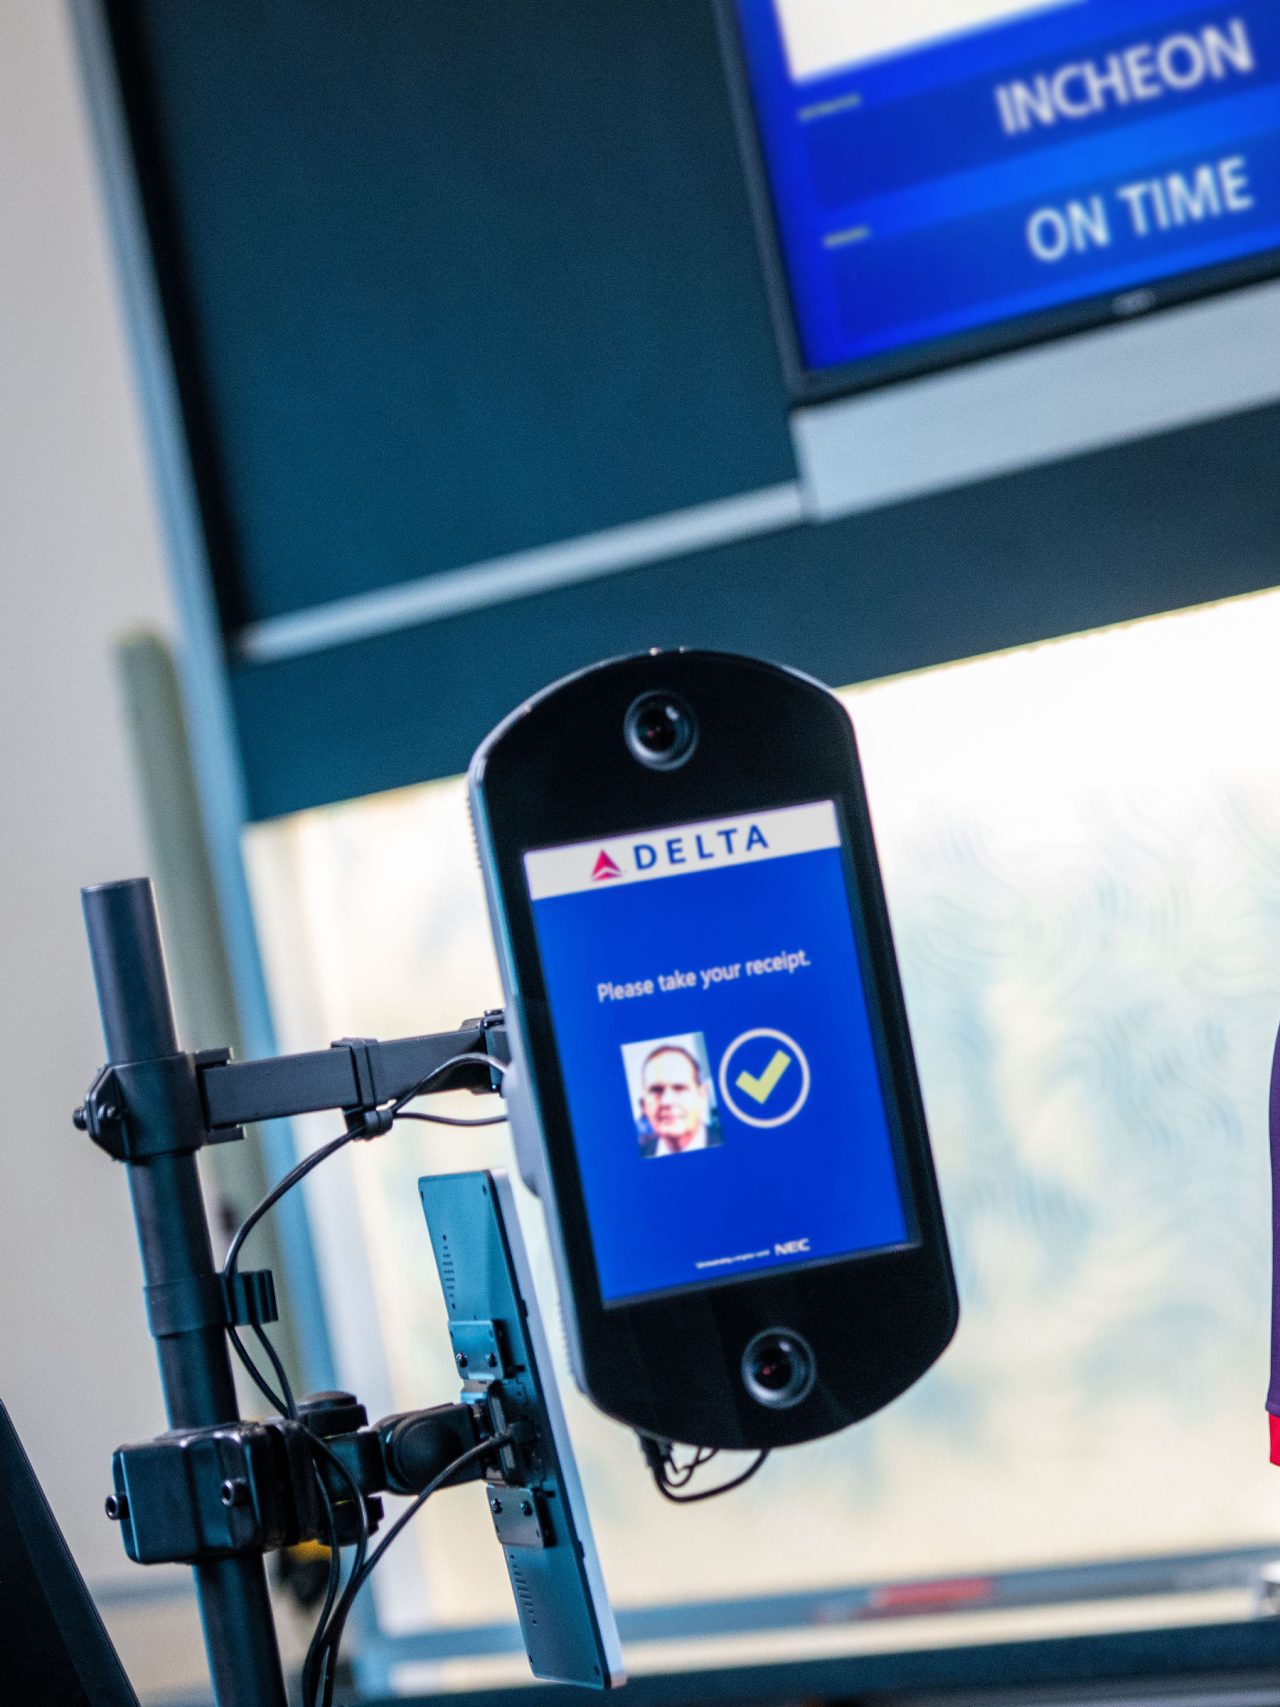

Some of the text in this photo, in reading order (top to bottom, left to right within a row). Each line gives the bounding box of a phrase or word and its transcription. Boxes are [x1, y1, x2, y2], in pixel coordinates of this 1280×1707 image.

[995, 19, 1255, 134] INCHEON
[1027, 156, 1253, 261] ON TIME
[633, 824, 769, 871] DELTA
[597, 949, 811, 1003] Please take your receipt.
[774, 1238, 810, 1256] NEC
